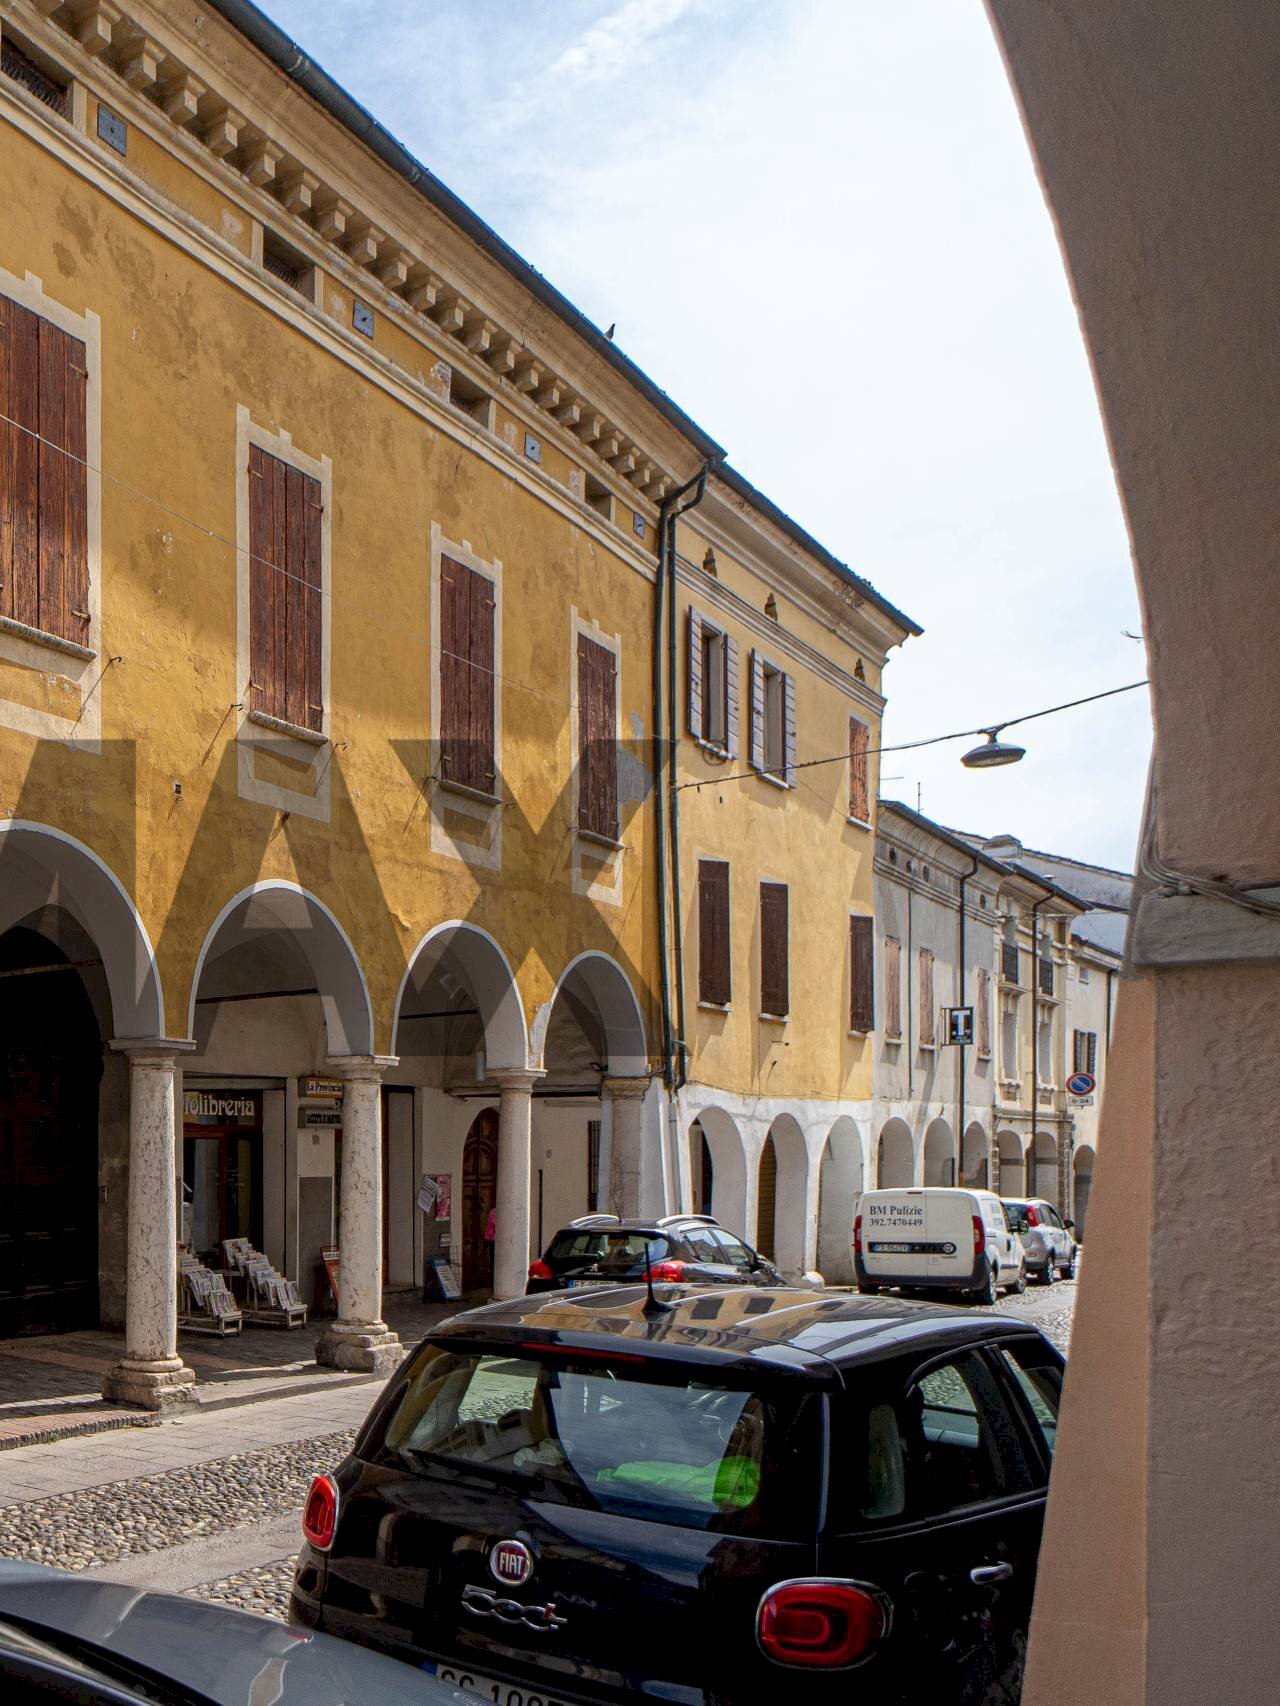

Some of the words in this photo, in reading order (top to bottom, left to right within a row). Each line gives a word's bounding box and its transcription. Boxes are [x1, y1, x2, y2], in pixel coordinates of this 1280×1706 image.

[316, 1081, 342, 1092] Provincia
[870, 1205, 886, 1215] BM
[890, 1205, 923, 1215] Pulizie
[499, 1552, 524, 1575] FIAT
